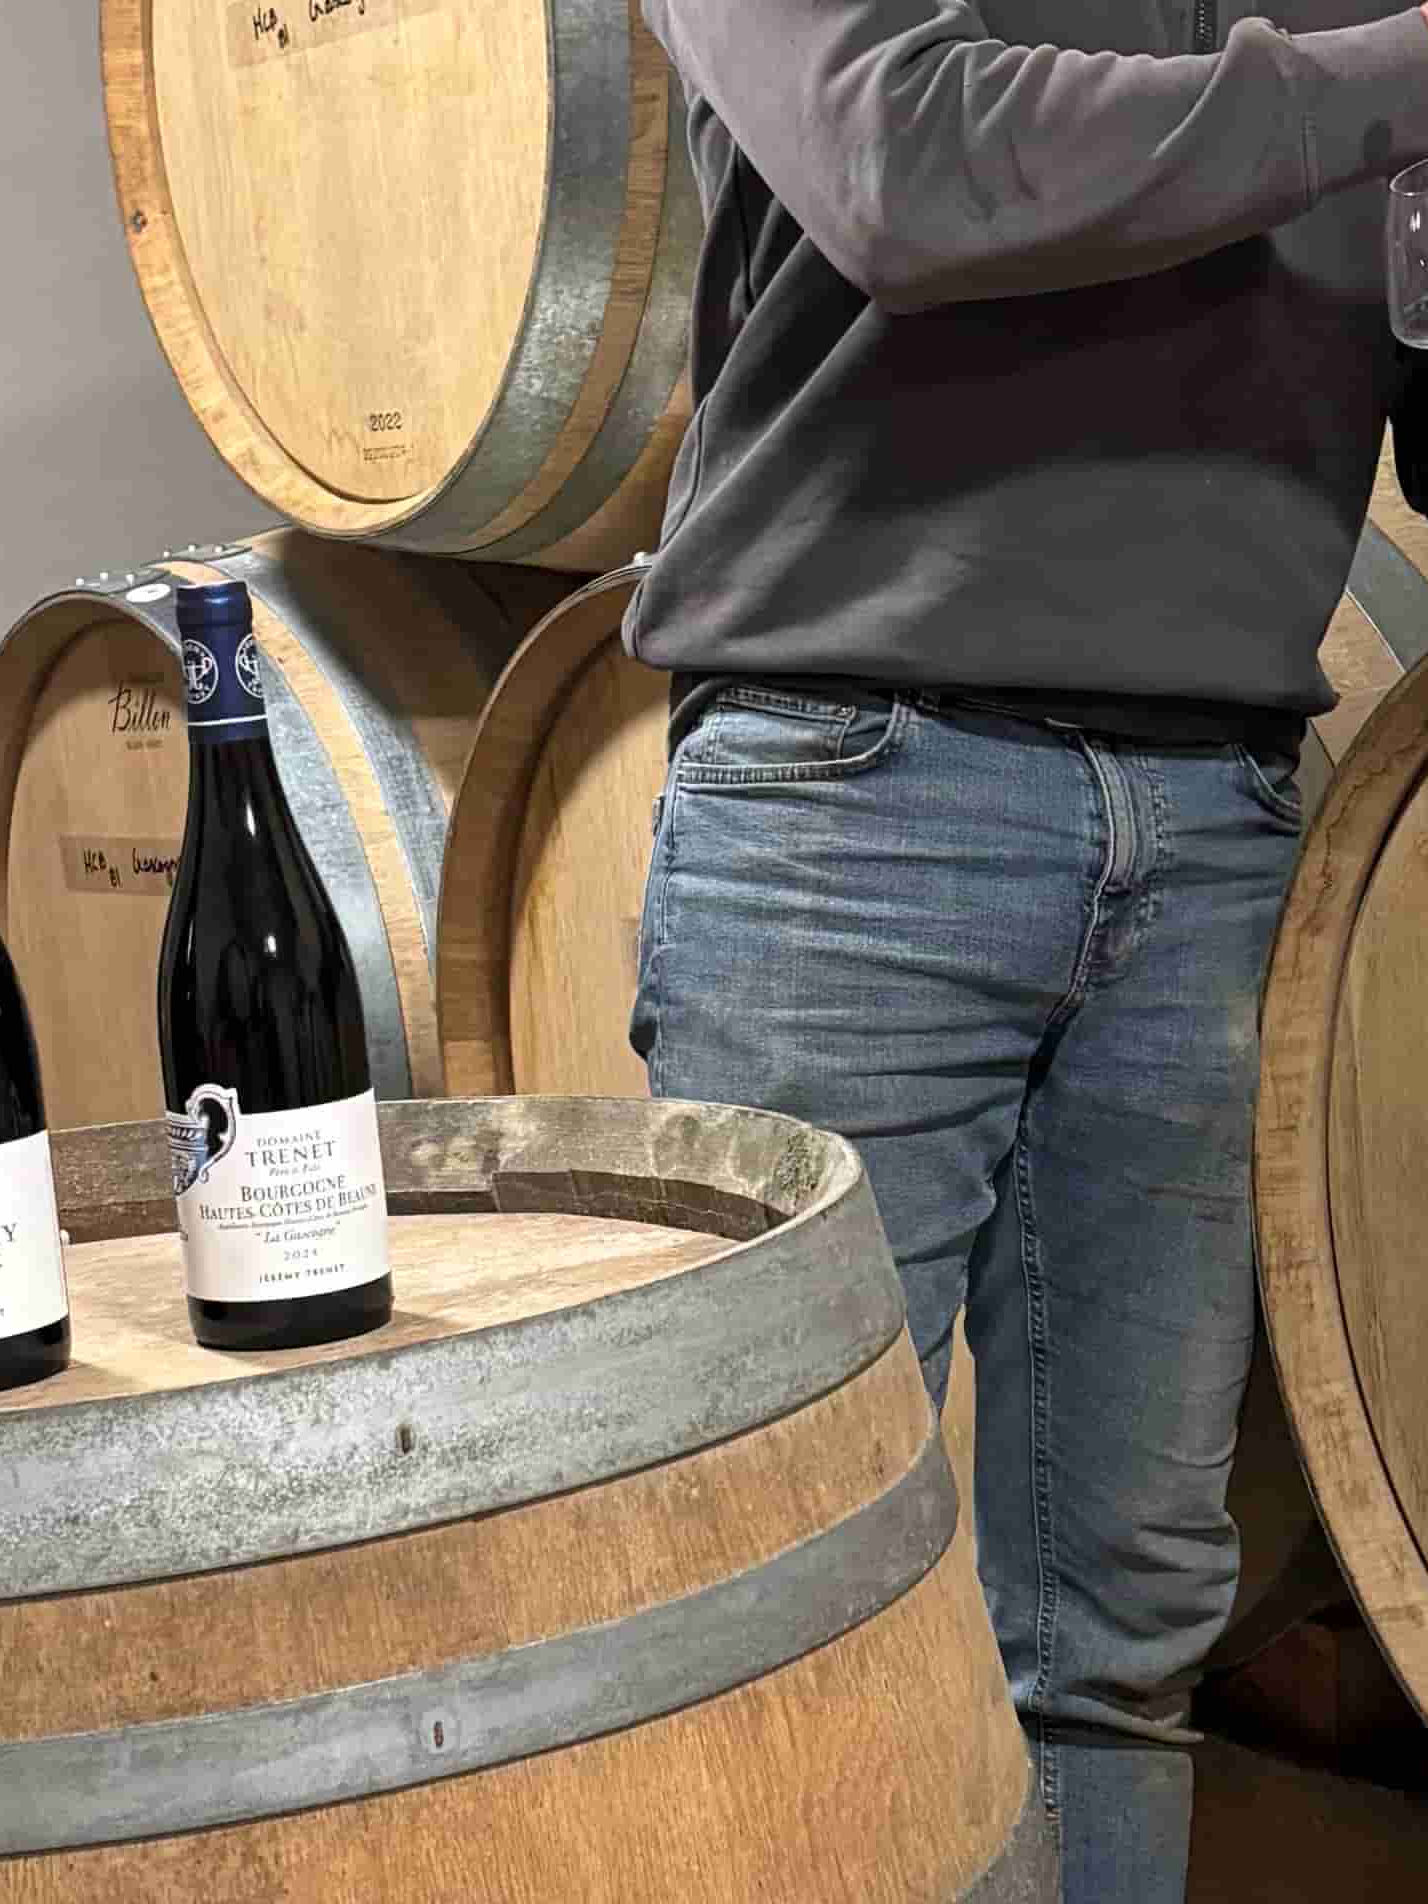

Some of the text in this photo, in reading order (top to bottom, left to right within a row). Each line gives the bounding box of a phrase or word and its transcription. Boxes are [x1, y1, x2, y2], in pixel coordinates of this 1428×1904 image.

[370, 411, 402, 432] 2022
[108, 680, 171, 736] Billon
[244, 1140, 336, 1167] TRENET
[240, 1175, 346, 1202] BOURGOGNE
